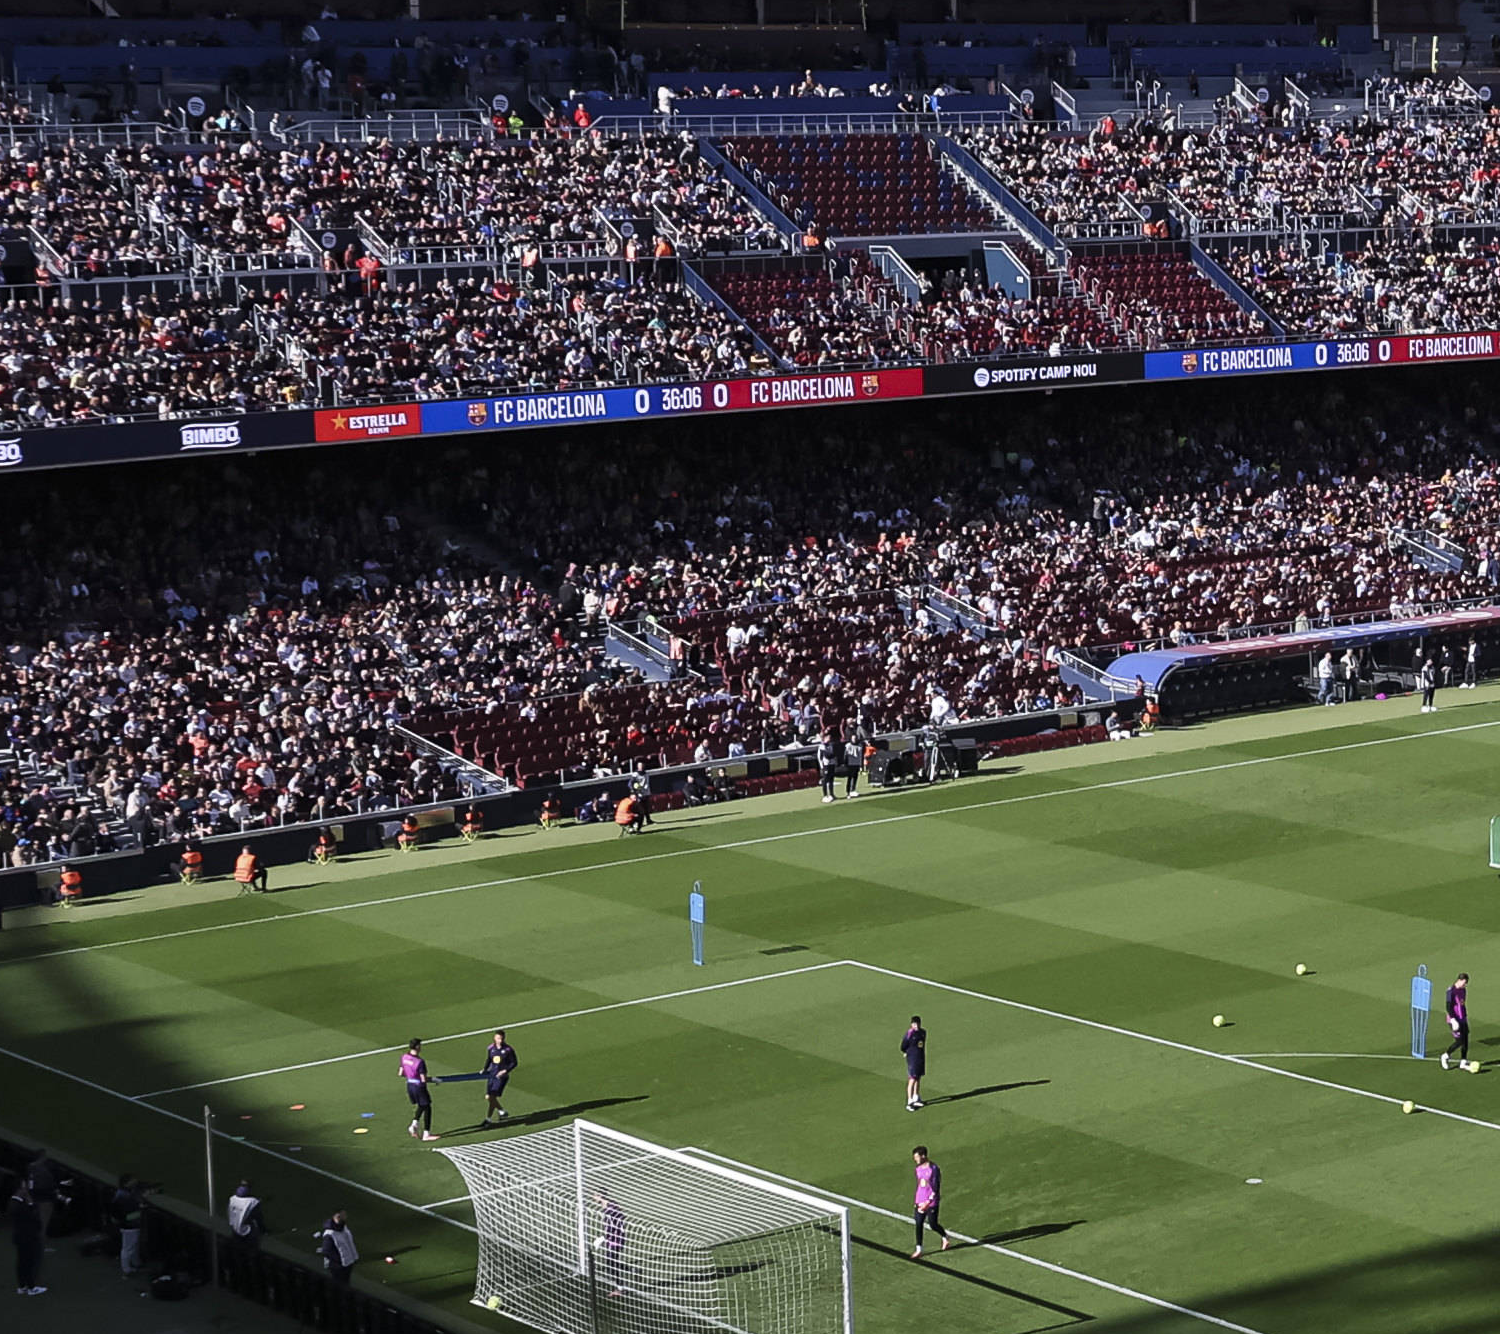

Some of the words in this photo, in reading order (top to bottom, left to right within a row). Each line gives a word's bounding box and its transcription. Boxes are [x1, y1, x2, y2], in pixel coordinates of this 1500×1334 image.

[1203, 351, 1219, 372] FC
[1221, 347, 1293, 370] BARCELONA
[1315, 344, 1328, 365] 0
[1337, 343, 1369, 364] 36:06
[1379, 340, 1391, 361] 0
[1409, 339, 1423, 359] FC
[1425, 335, 1493, 357] BARCELONA
[991, 366, 1036, 384] SPOTIFY
[1039, 365, 1070, 381] CAMP
[1072, 363, 1097, 379] NOU
[495, 400, 514, 424] FC
[517, 394, 606, 422] BARCELONA
[635, 389, 650, 414] 0
[661, 386, 702, 412] 36:06
[713, 384, 728, 408] 0
[751, 380, 769, 404] FC
[772, 376, 855, 402] BARCELONA
[349, 412, 407, 430] ESTRELLA
[182, 426, 240, 445] BIMBO
